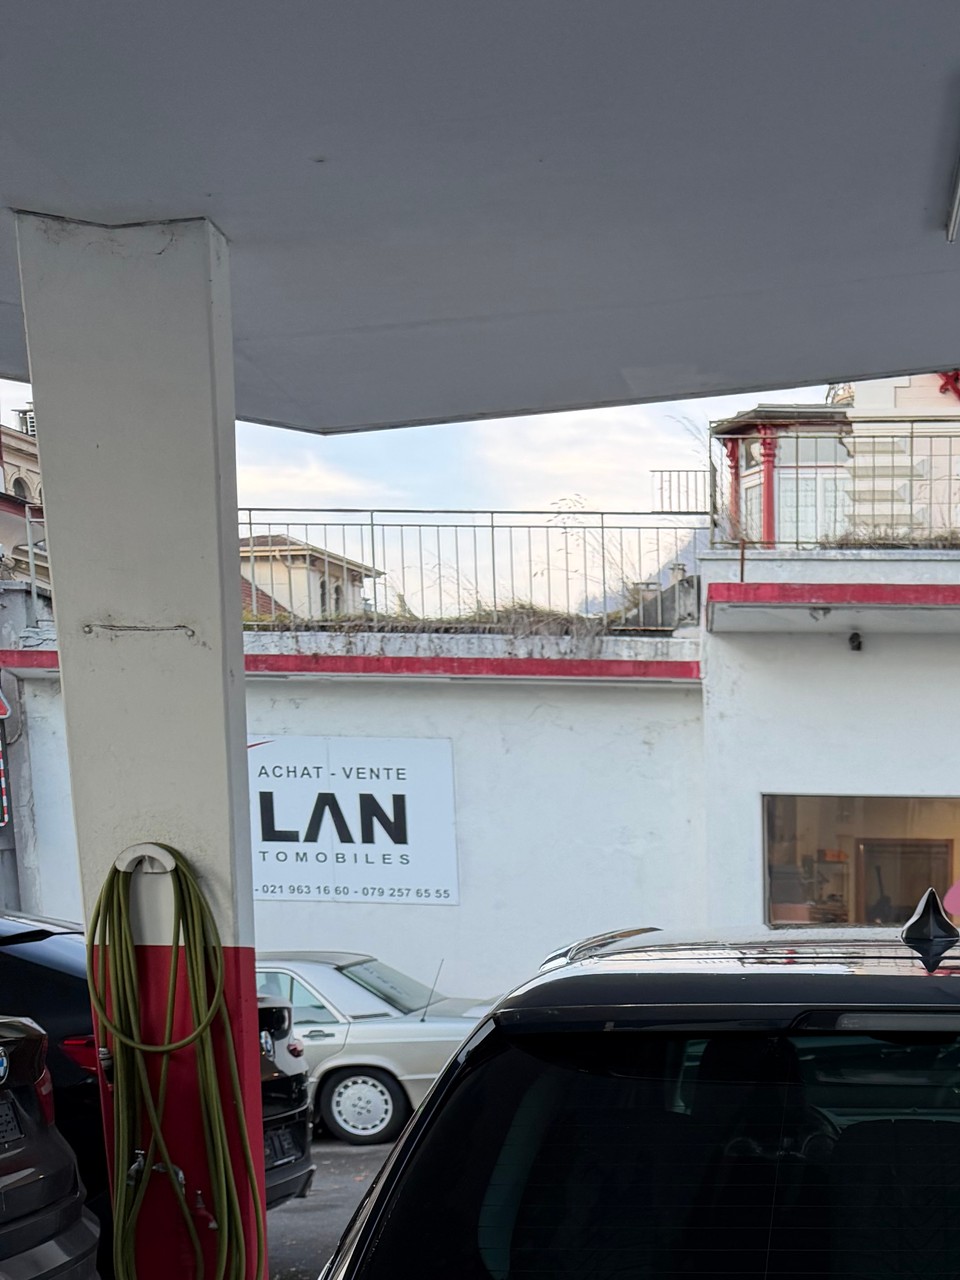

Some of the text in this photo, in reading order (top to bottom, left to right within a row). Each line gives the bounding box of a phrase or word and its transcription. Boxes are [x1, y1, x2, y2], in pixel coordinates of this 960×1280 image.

[258, 765, 323, 779] ACHAT
[342, 766, 407, 780] VENTE
[259, 791, 408, 845] LAN
[258, 851, 411, 865] TOMOBILES
[262, 884, 284, 894] 021
[288, 885, 311, 894] 963
[316, 885, 330, 895] 16
[334, 886, 349, 895] 60
[362, 887, 385, 897] 079
[389, 887, 411, 897] 257
[416, 888, 431, 898] 65
[435, 889, 450, 899] 55
